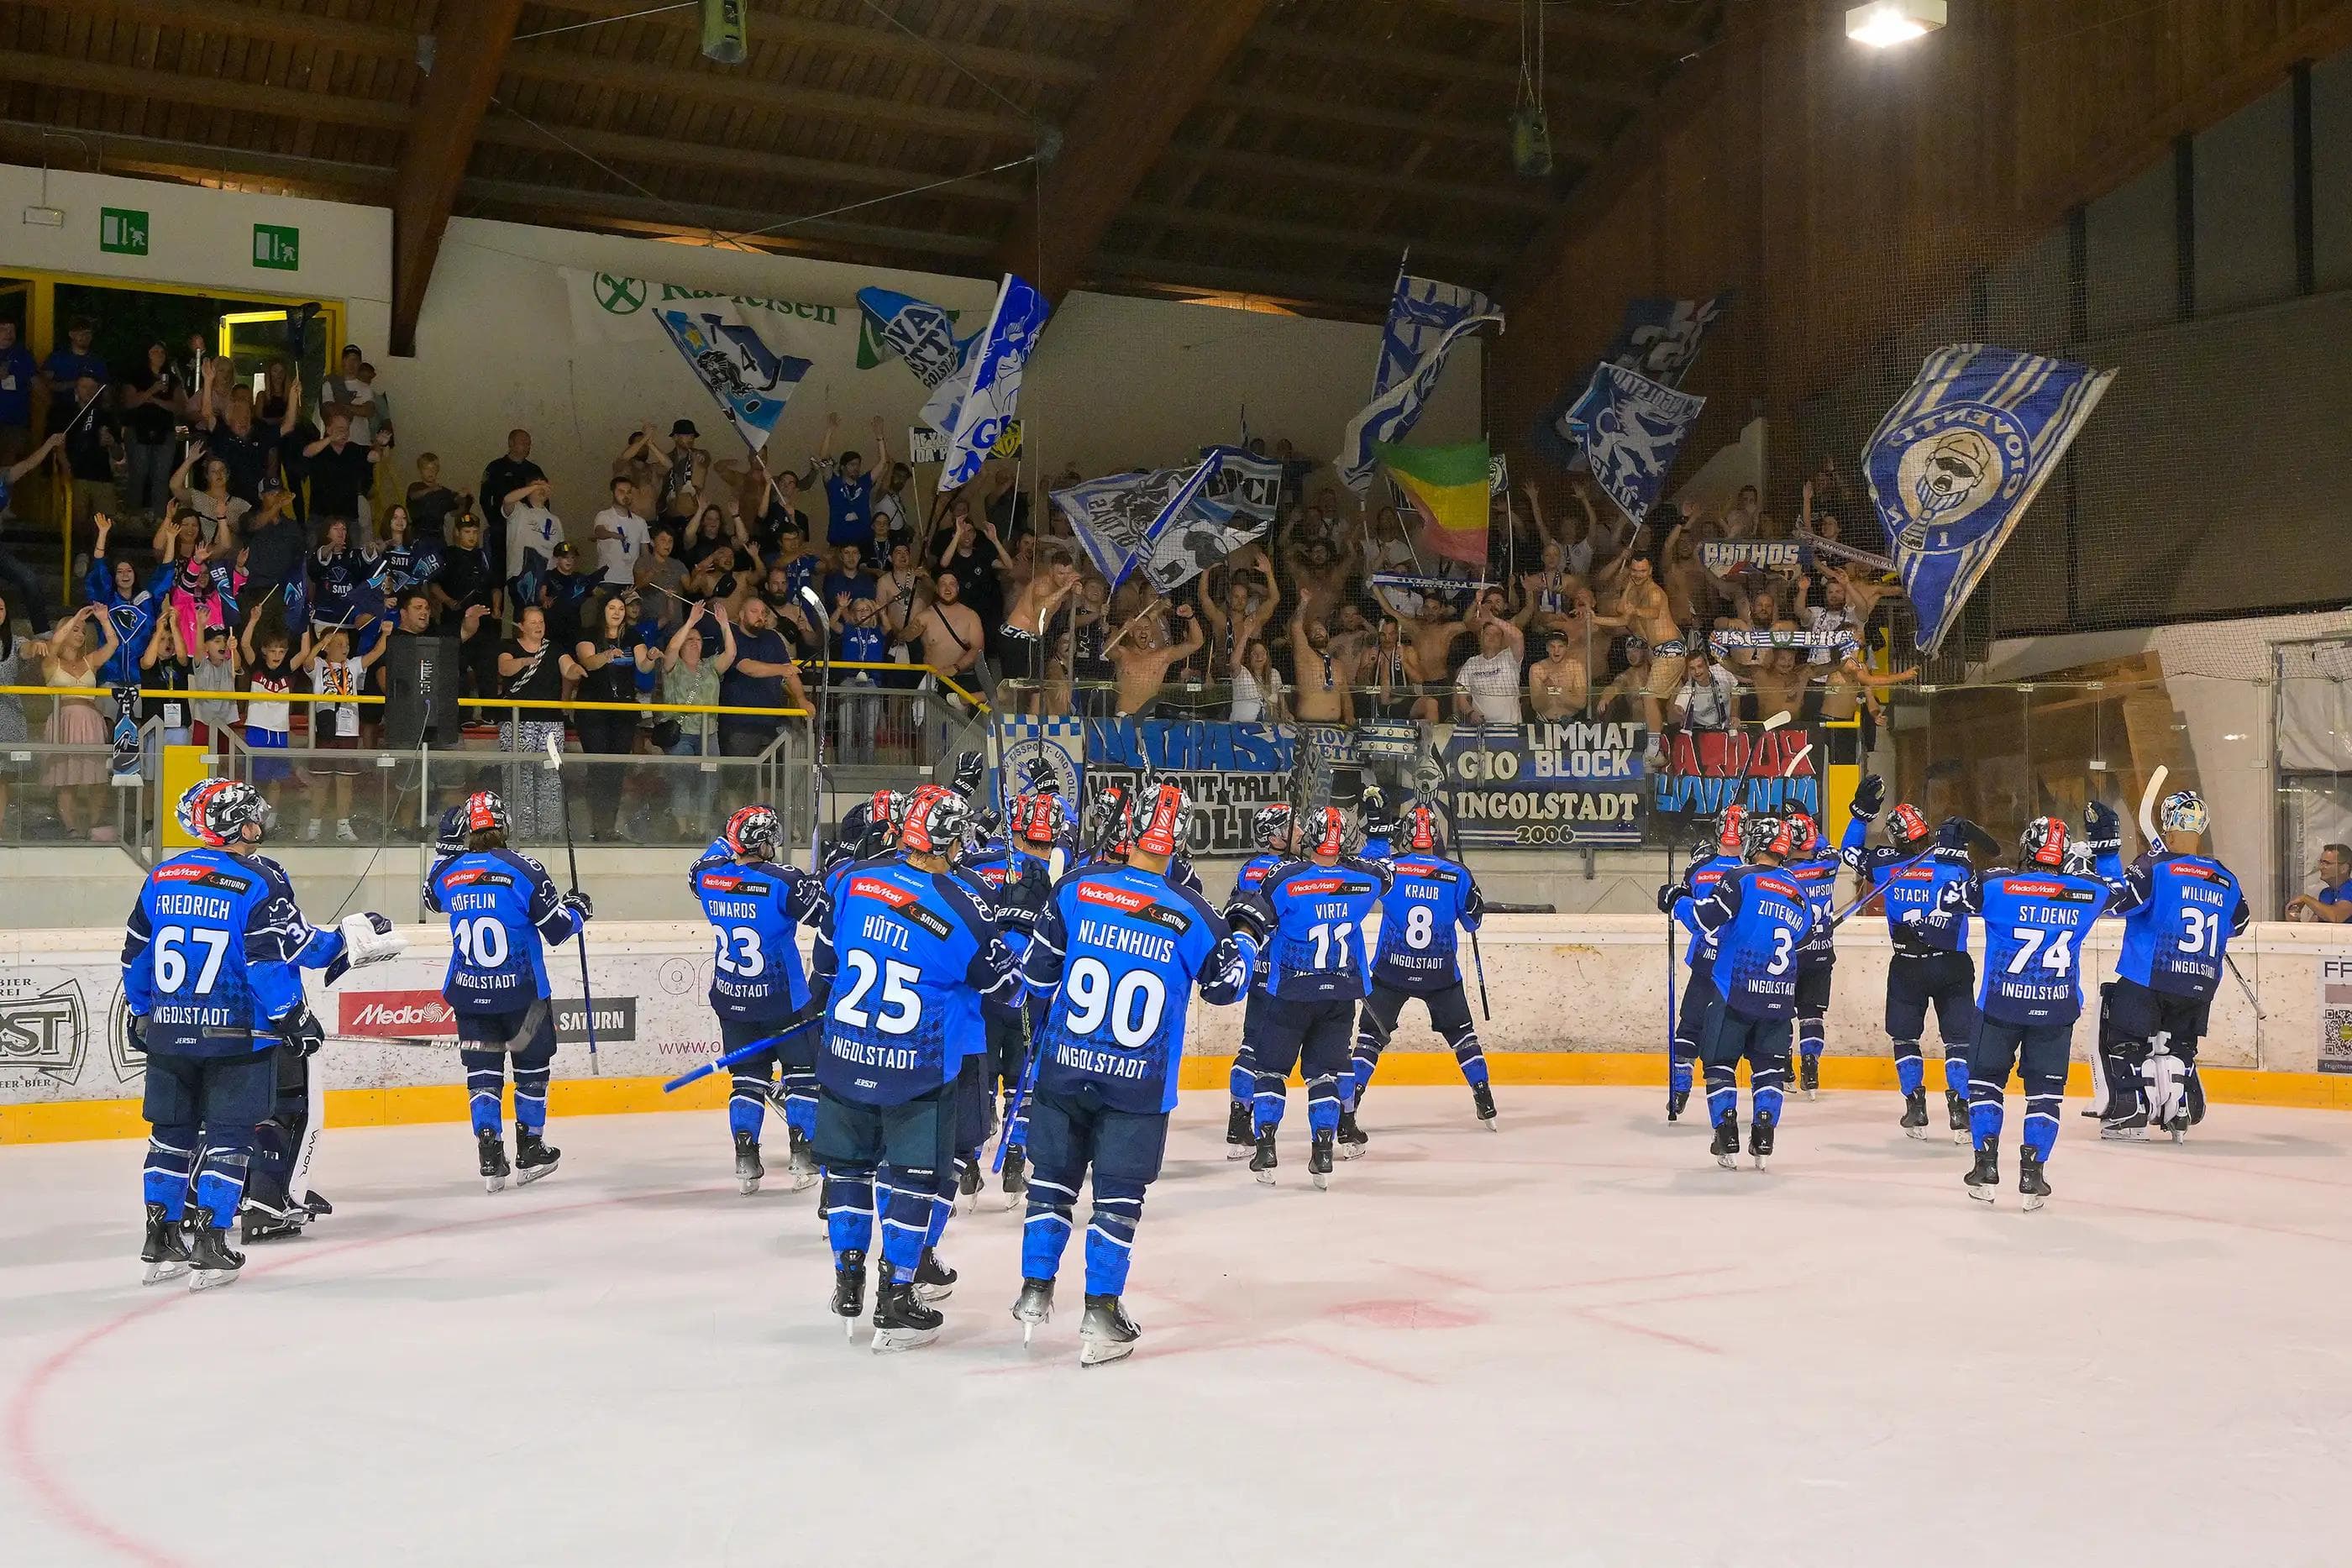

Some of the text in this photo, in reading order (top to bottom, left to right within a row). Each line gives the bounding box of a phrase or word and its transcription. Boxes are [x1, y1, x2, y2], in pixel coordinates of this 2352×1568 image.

[1527, 723, 1636, 750] LIMMAT
[1054, 750, 1068, 769] UND
[1065, 771, 1076, 804] ROLLS
[1536, 749, 1631, 777] BLOCK
[1456, 791, 1638, 821] INGOLSTADT
[1515, 824, 1576, 844] 2006
[218, 878, 246, 891] SATURN
[746, 885, 767, 894] SATURN
[2181, 885, 2224, 908] WILLIAMS
[155, 894, 231, 920] FRIEDRICH
[708, 900, 756, 920] EDWARDS
[1315, 903, 1348, 920] VIRTA
[2019, 905, 2079, 926] ST.DENIS
[863, 914, 910, 952] HÜTTL
[920, 913, 948, 936] SATURN
[1405, 905, 1434, 950] 8
[2178, 907, 2219, 958] 31
[454, 917, 508, 968] 10
[715, 925, 765, 978] 23
[1077, 919, 1176, 964] NIJENHUIS
[1308, 922, 1354, 969] 11
[1767, 927, 1793, 975] 3
[2007, 928, 2073, 978] 74
[154, 926, 229, 995] 67
[1389, 952, 1444, 970] INGOLSTADT
[2171, 960, 2215, 980] INGOLSTADT
[455, 973, 517, 989] INGOLSTADT
[834, 948, 922, 1035] 25
[2002, 982, 2069, 999] INGOLSTADT
[153, 1006, 230, 1026] INGOLSTADT
[1065, 957, 1166, 1048] 90
[559, 1010, 625, 1031] SATURN
[659, 1041, 720, 1055] www.o
[832, 1035, 918, 1071] INGOLSTADT
[1056, 1044, 1147, 1079] INGOLSTADT
[299, 1128, 319, 1177] VAPOR
